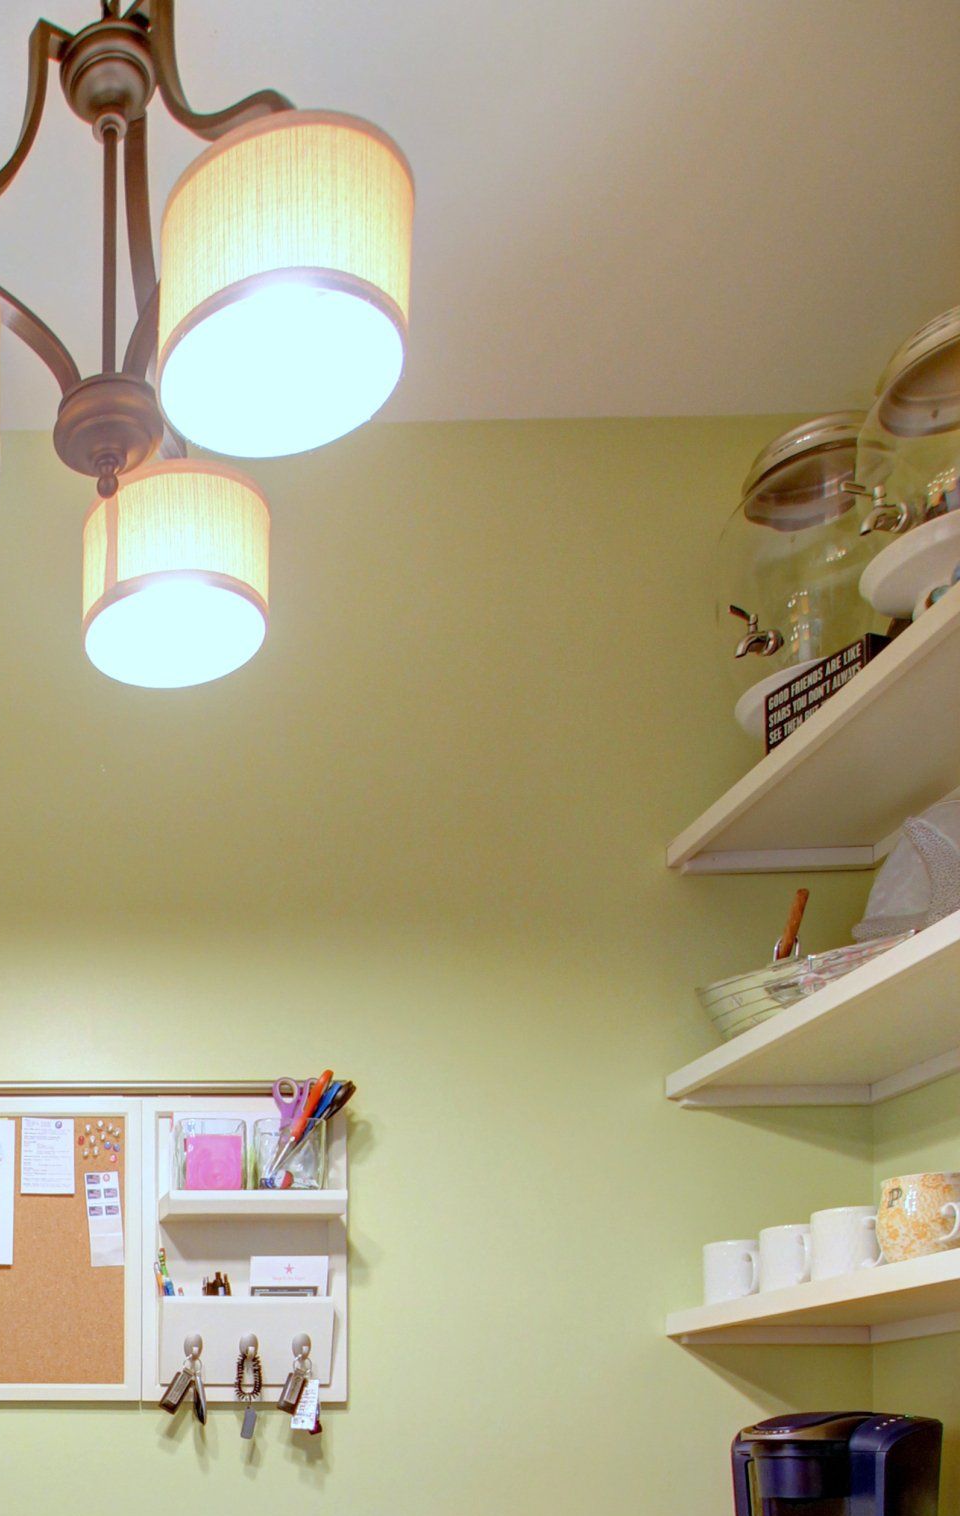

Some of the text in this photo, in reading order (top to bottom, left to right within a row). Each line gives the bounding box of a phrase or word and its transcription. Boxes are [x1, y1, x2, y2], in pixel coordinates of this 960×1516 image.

[768, 642, 862, 711] GOOD FRIENDS ARE LIKE
[768, 704, 791, 728] STARS
[792, 693, 808, 714] YOU
[808, 680, 830, 705] DON'T
[768, 727, 783, 745] SEE
[783, 713, 804, 736] THEM
[887, 1187, 902, 1208] P
